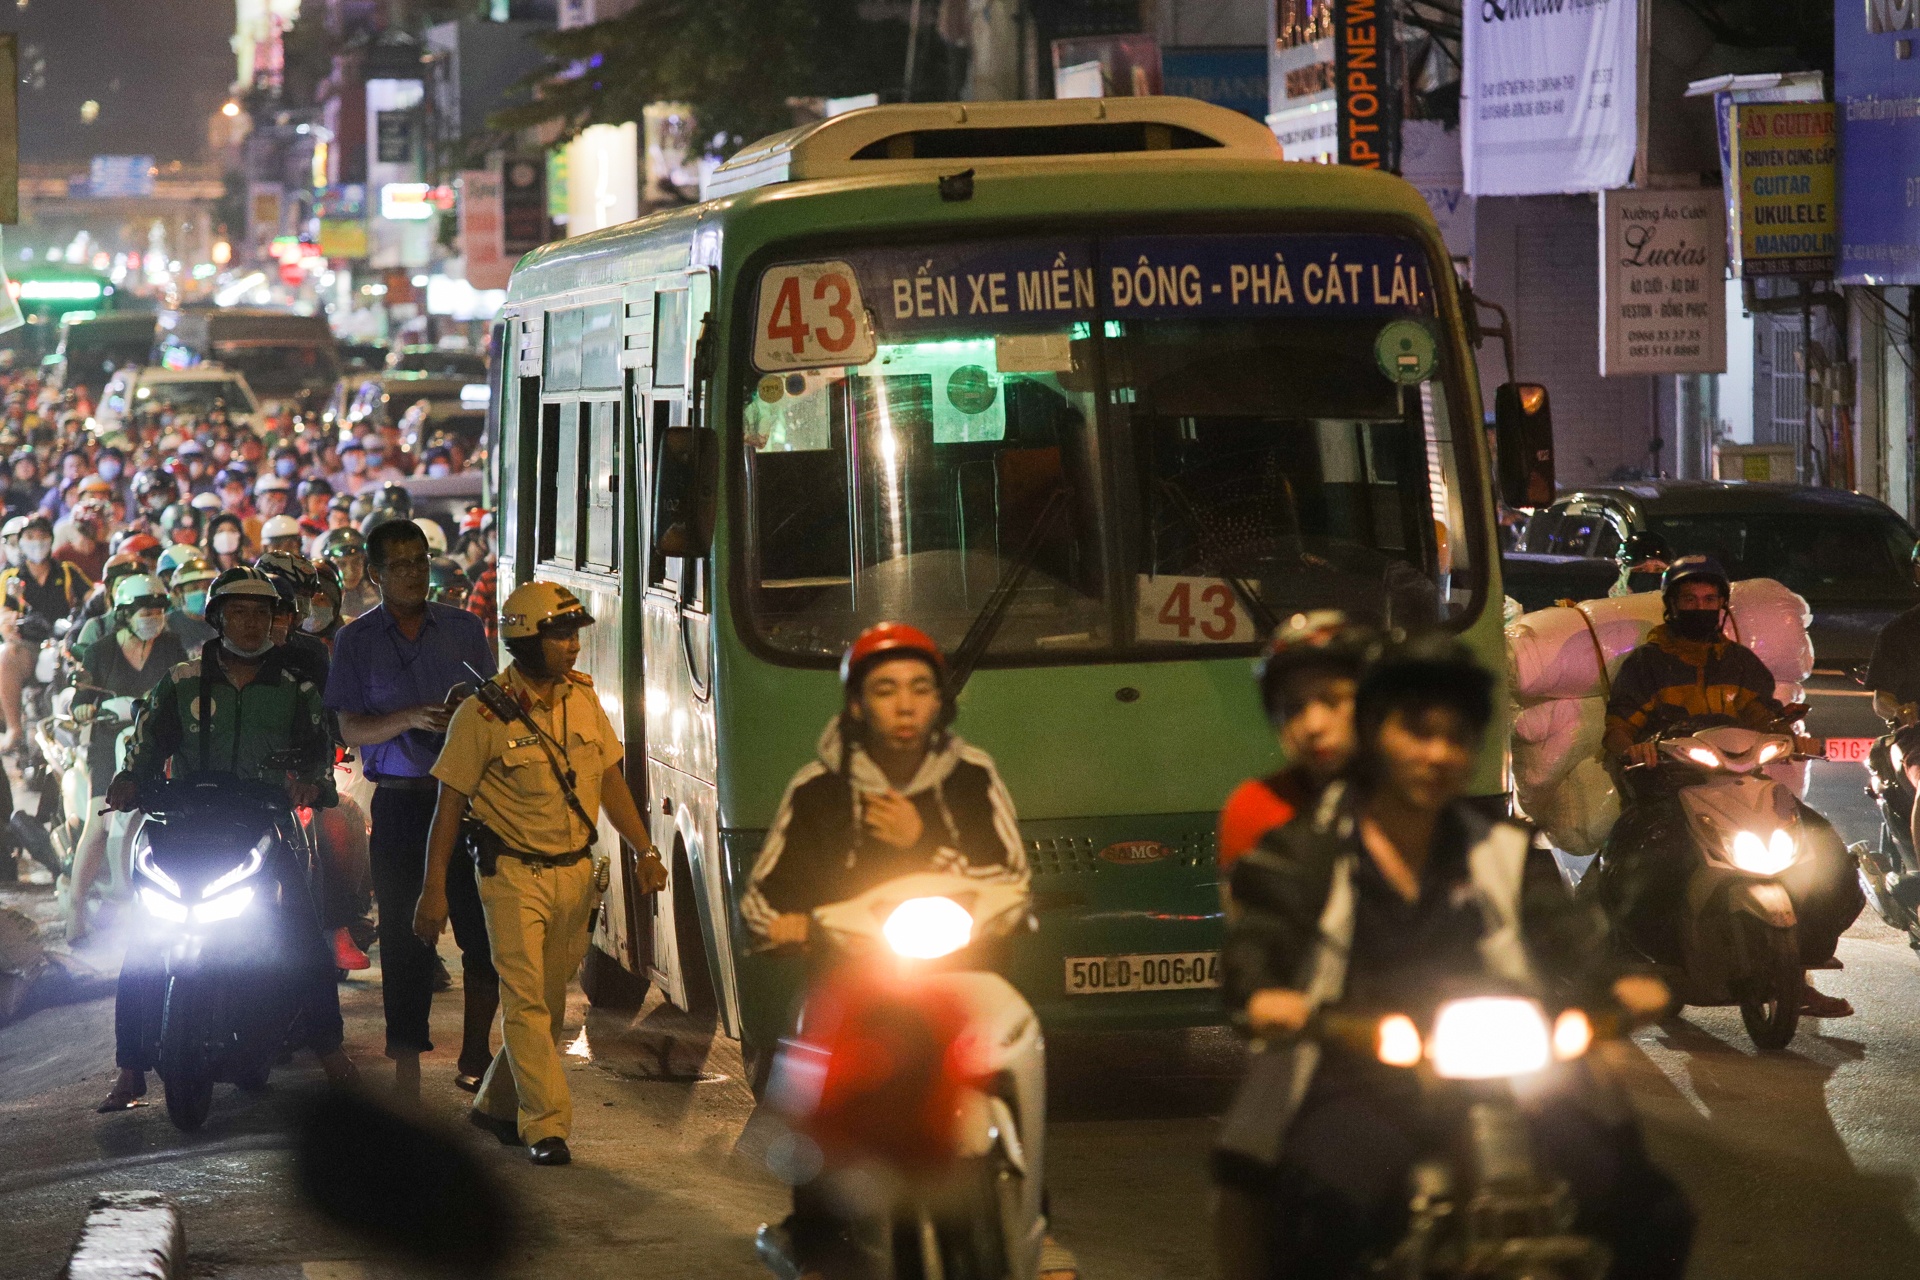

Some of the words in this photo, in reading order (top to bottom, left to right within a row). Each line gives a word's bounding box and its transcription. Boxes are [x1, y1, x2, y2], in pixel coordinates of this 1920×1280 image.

[1787, 148, 1814, 167] CUNG
[1753, 175, 1811, 197] GUITAR
[1755, 204, 1827, 226] UKULELE
[1620, 224, 1706, 268] Lucias
[892, 259, 959, 320] BẾN
[967, 272, 1010, 315] XE
[1017, 251, 1095, 311] MIỀN
[1112, 255, 1202, 307] ĐÔNG
[1230, 252, 1294, 304] PHÀ
[1303, 252, 1362, 305] CÁT
[1372, 253, 1419, 305] LÁI
[767, 273, 856, 354] 43
[1158, 583, 1237, 640] 43
